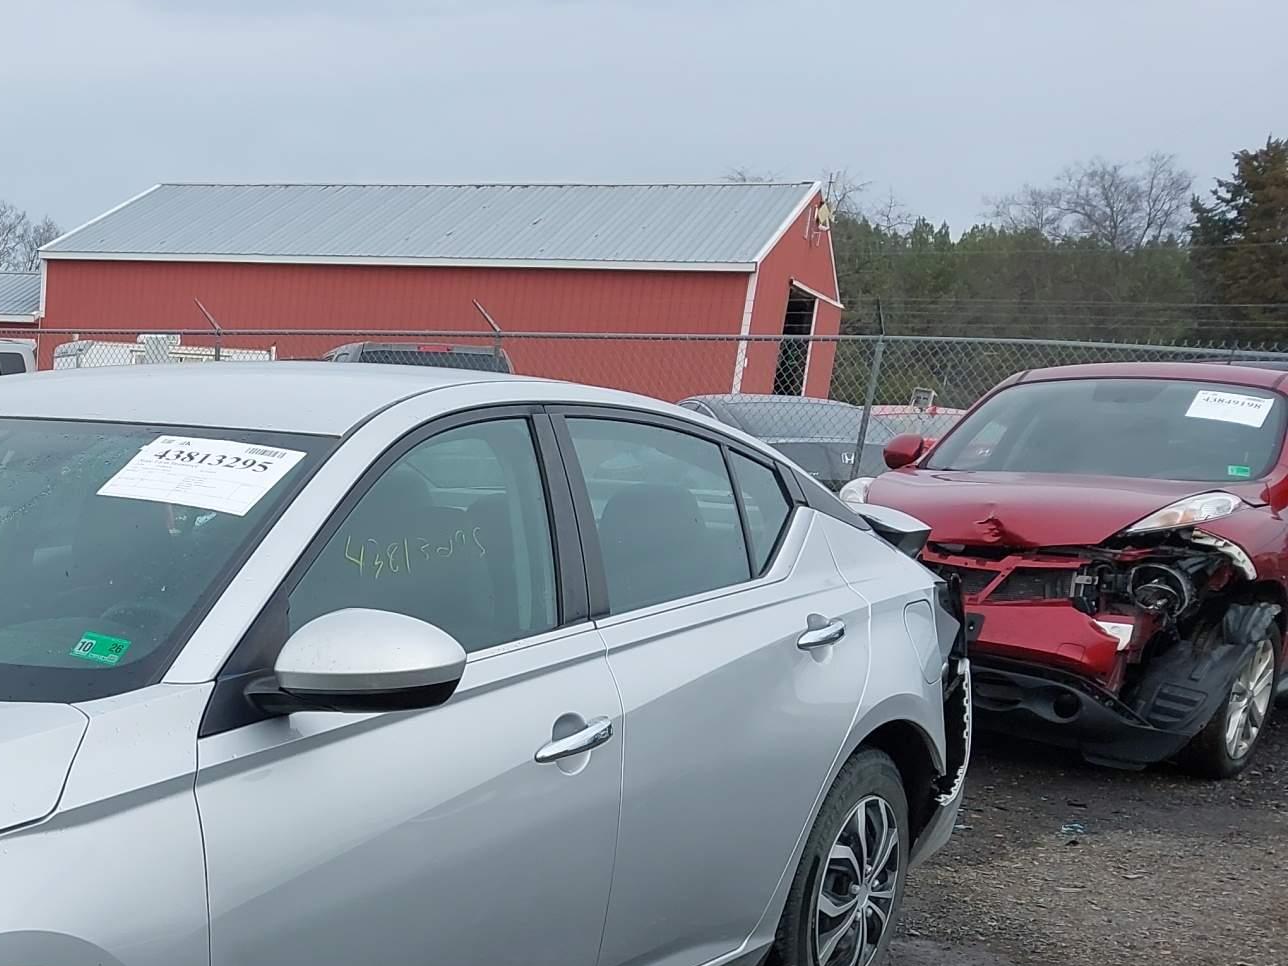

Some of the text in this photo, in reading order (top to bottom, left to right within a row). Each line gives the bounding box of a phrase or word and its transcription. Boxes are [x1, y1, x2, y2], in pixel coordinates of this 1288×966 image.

[154, 447, 274, 473] 43813295
[78, 640, 124, 654] 10 26
